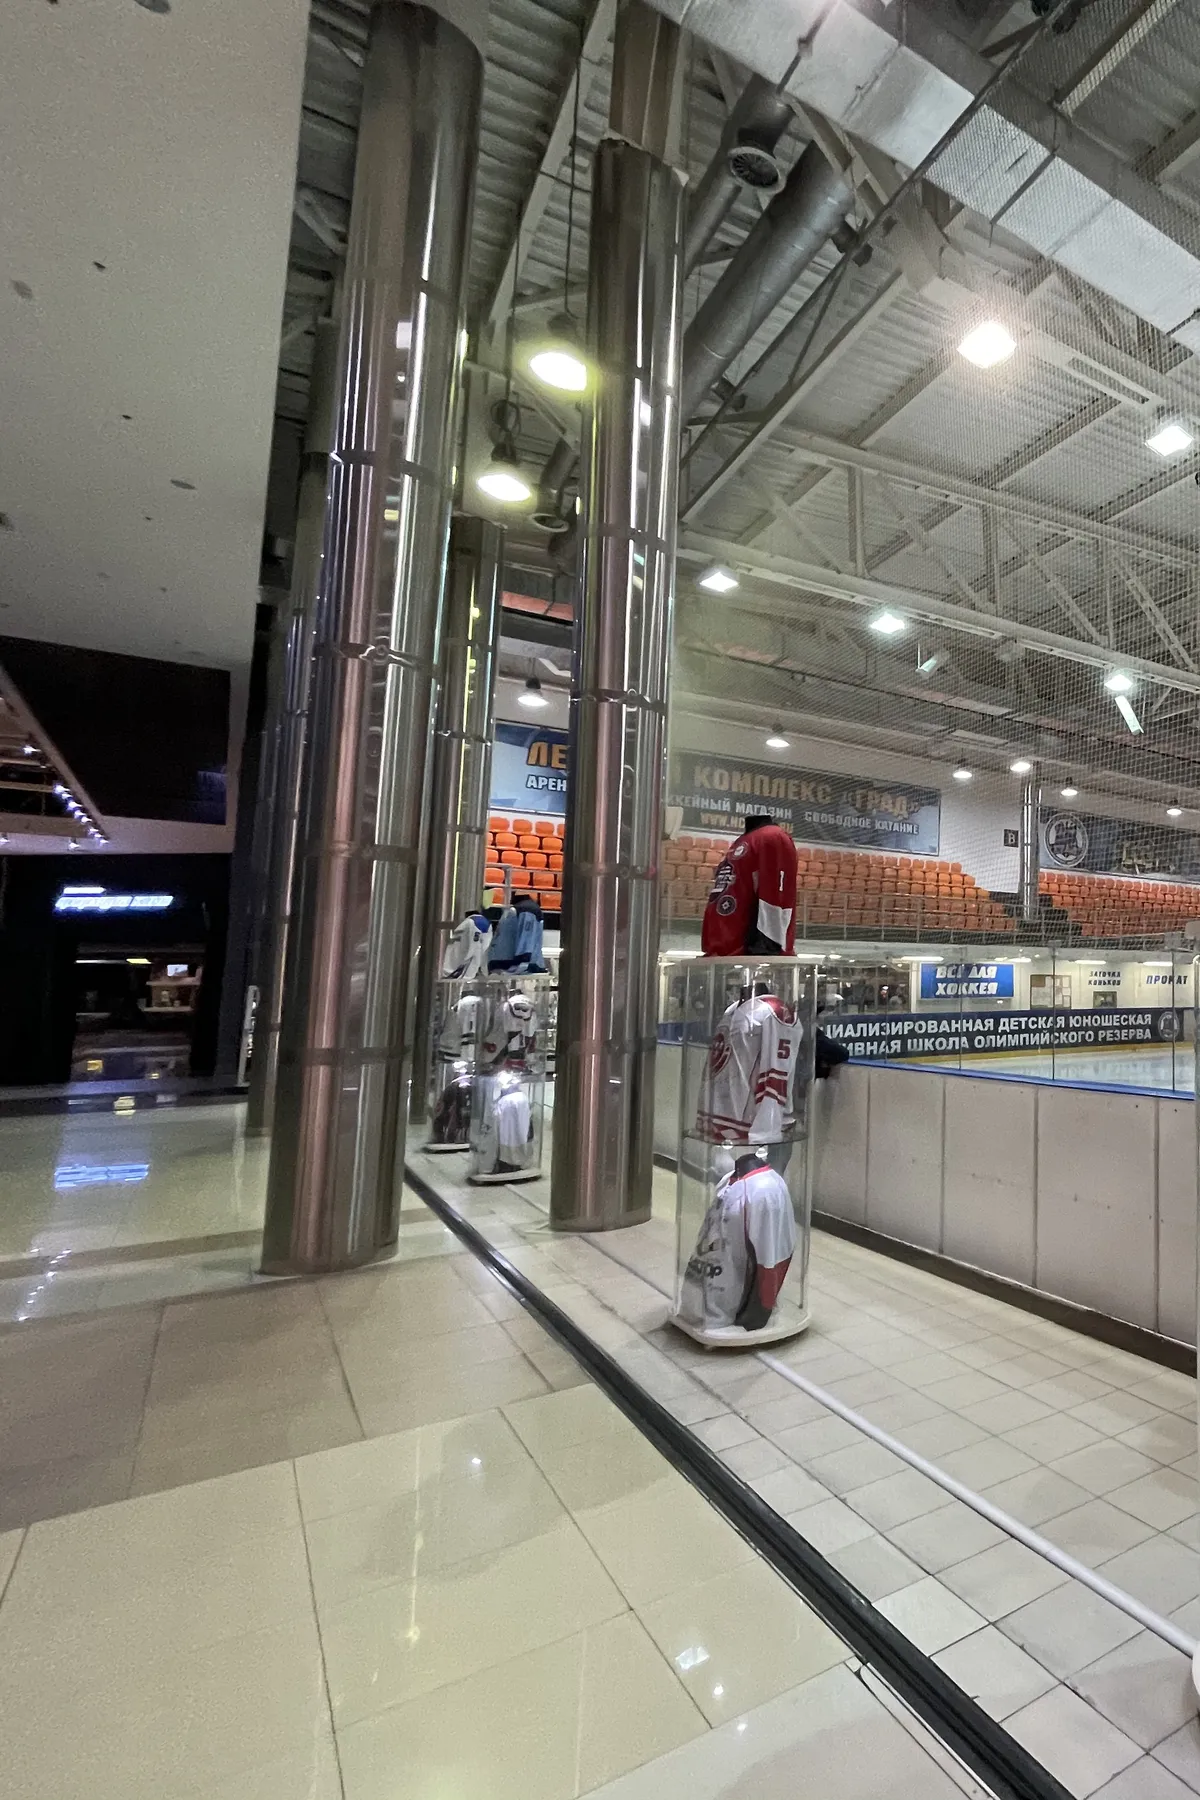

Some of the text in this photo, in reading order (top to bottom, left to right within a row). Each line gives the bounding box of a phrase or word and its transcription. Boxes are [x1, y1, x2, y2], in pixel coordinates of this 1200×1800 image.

[694, 765, 833, 804] КОМПЛЕКС
[735, 801, 793, 820] МАГАЗИН
[804, 811, 920, 835] СВОБОДНОЕ КАТАНИЕ
[968, 965, 998, 979] ДЛЯ
[1146, 975, 1188, 985] ПРОКАТ
[935, 982, 998, 996] ХОККЕЯ
[998, 1016, 1065, 1032] ДЕТСКАЯ
[1069, 1013, 1152, 1028] ЮНОШЕСКАЯ
[777, 1038, 791, 1060] 5
[840, 1027, 1152, 1057] ИВНАЯ ШКОЛА ОЛИМПИЙСКОГО РЕЗЕРВА
